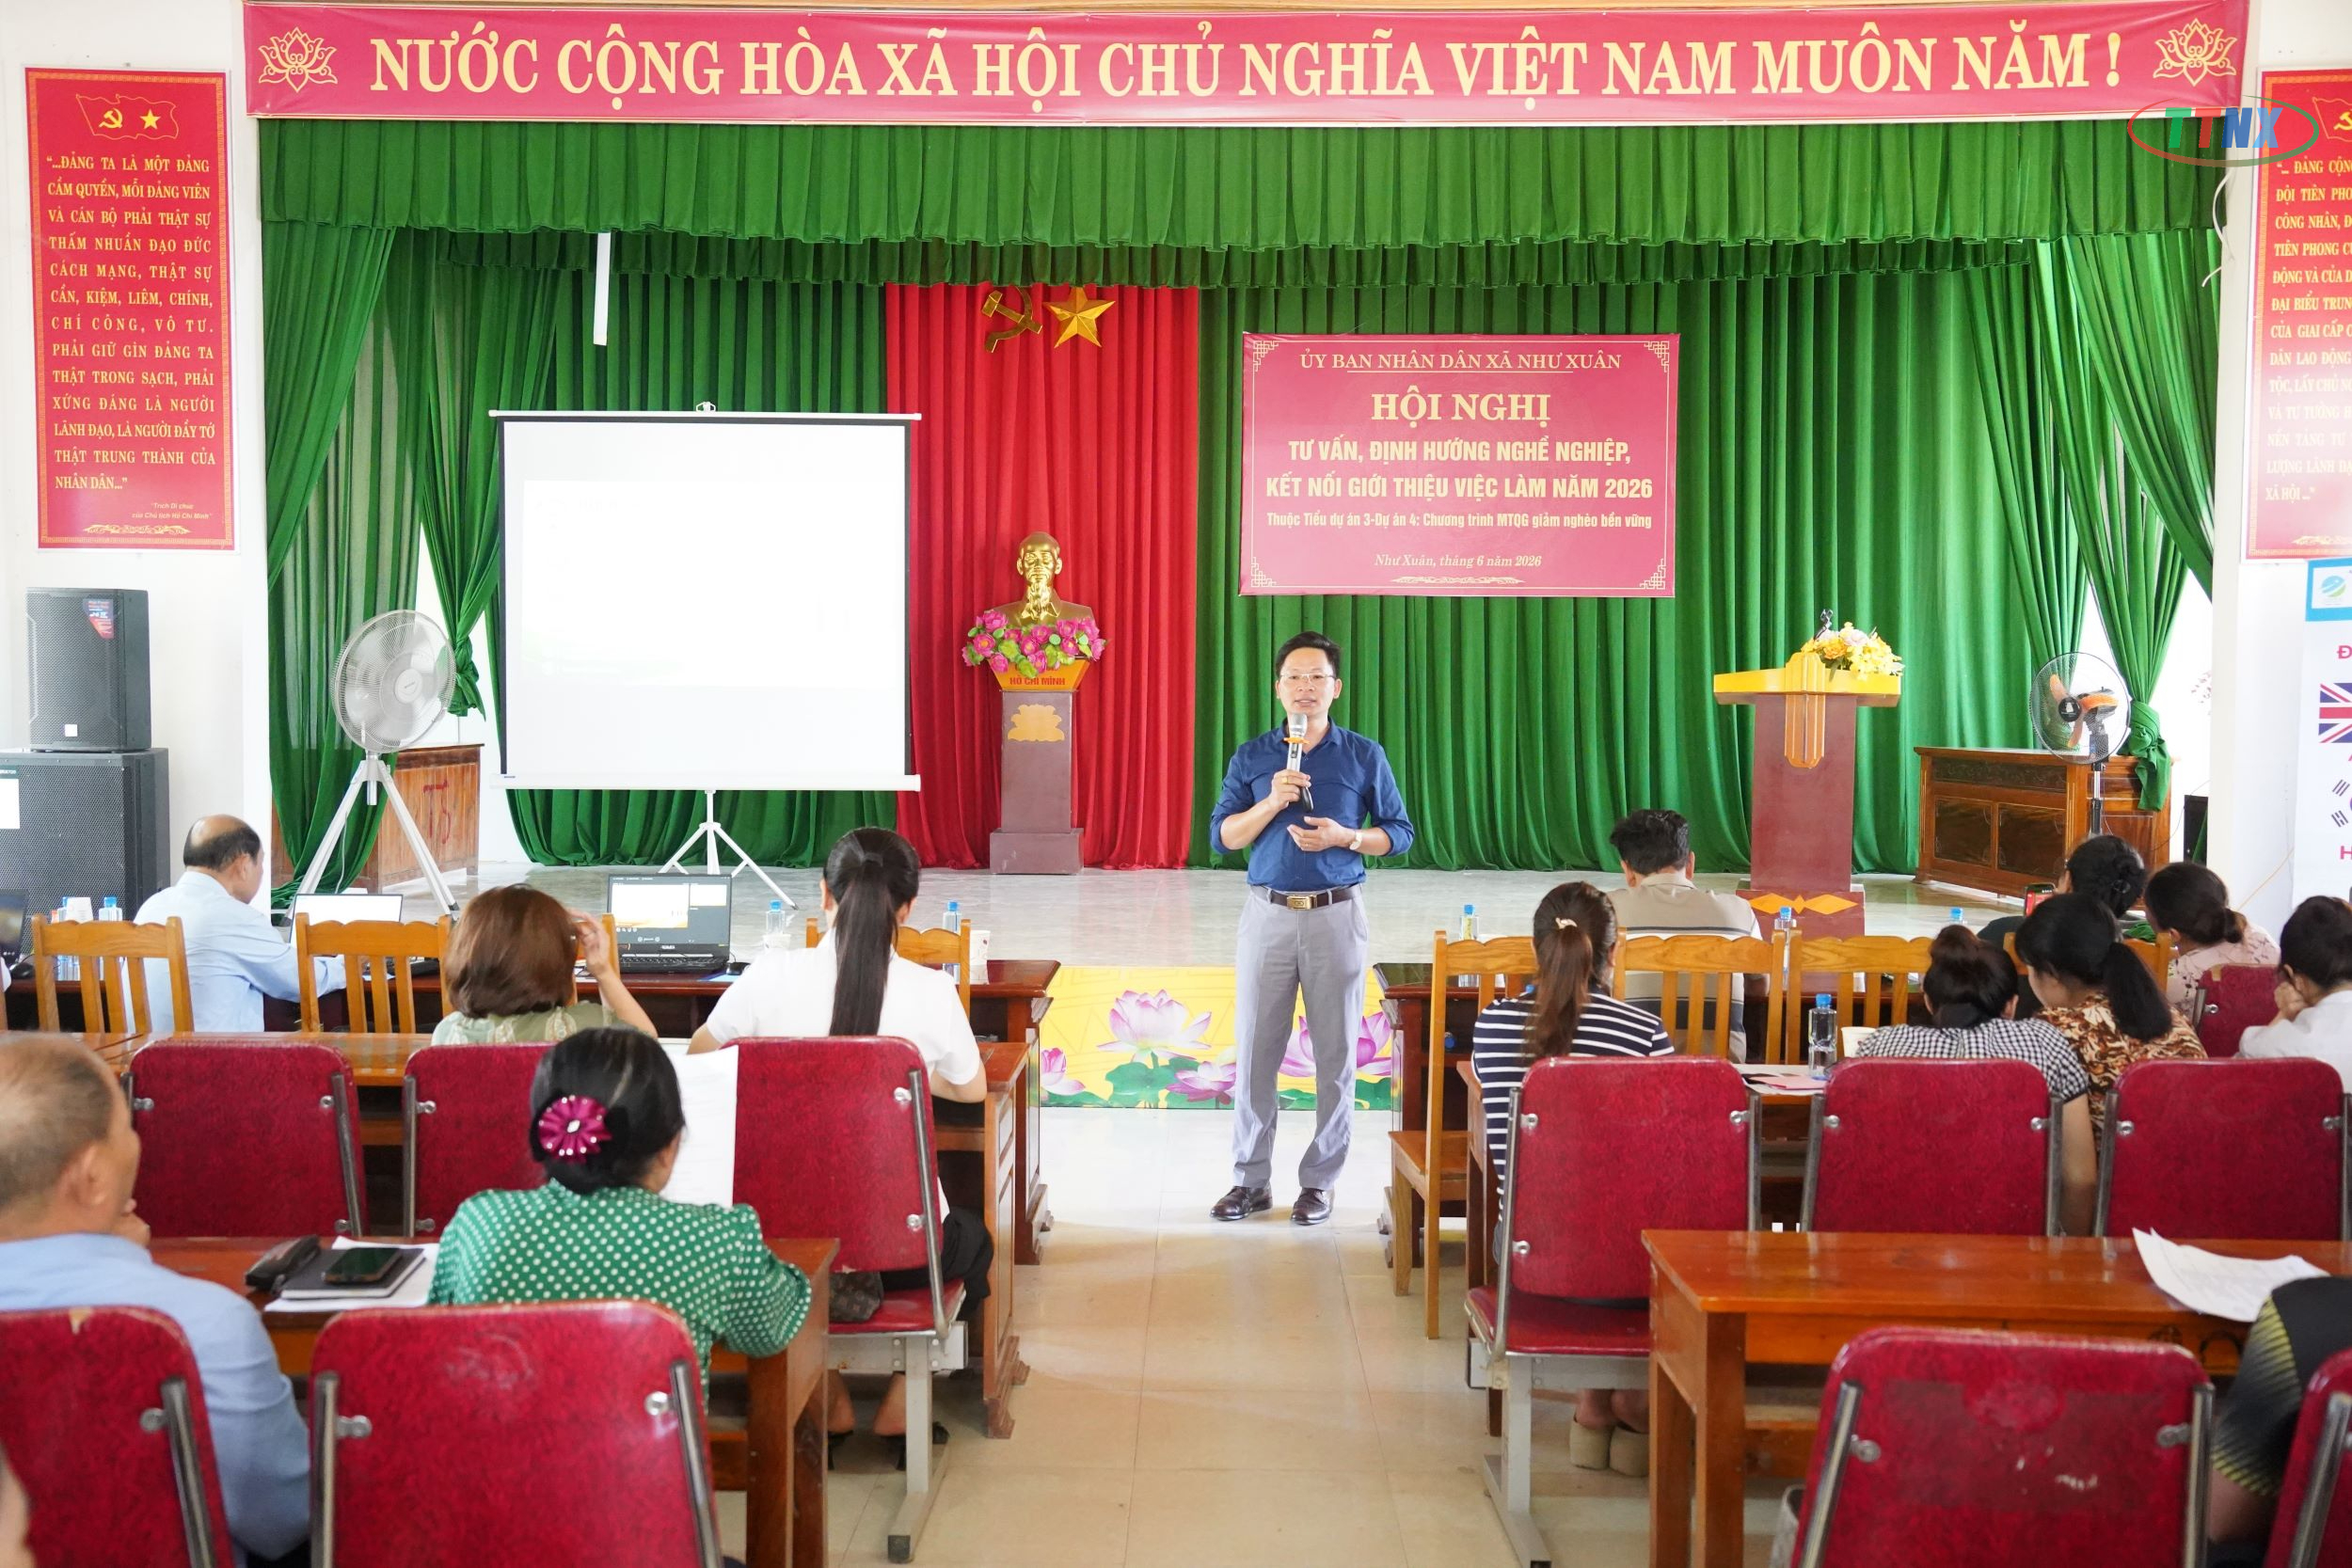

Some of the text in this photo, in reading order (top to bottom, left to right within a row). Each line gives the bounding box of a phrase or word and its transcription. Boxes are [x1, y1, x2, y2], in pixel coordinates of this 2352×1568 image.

[371, 21, 538, 94] NƯỚC
[557, 24, 723, 110] CỘNG
[739, 26, 866, 96] HÒA
[876, 27, 958, 96] XÃ
[972, 27, 1081, 113] HỘI
[1099, 21, 1224, 98] CHỦ
[1238, 28, 1435, 98] NGHĨA
[1446, 26, 1587, 111] VIỆT
[1601, 40, 1737, 96] NAM
[1752, 22, 1937, 95] MUÔN
[1950, 20, 2091, 92] NĂM
[101, 157, 116, 170] TA
[122, 154, 137, 171] LÀ
[145, 154, 169, 174] MỘT
[177, 154, 210, 173] ĐẢNG
[2328, 156, 2352, 176] CỘN
[2274, 239, 2340, 256] TIÊN PHONG
[51, 259, 213, 283] CÁCH MẠNG, THẬT SỰ
[53, 339, 214, 359] PHẢI GIỮ GÌN ĐẢNG TA
[1300, 348, 1621, 369] ỦY BAN NHÂN DÂN XÃ NHƯ XUÂN
[53, 366, 215, 388] THẬT TRONG SẠCH, PHẢI
[53, 394, 215, 412] XỨNG ĐÁNG LÀ NGƯỜI
[1372, 385, 1550, 428] HỘI NGHỊ
[55, 446, 215, 467] THẬT TRUNG THÀNH CỦA
[1289, 434, 1630, 466] TƯ VẤN, ĐỊNH HƯỚNG NGHỀ NGHIỆP,
[1266, 470, 1653, 502] KẾT NỐI GIỚI THIỆU VIỆC LÀM NĂM 2026
[1267, 512, 1300, 529] Thuộc
[1304, 510, 1327, 526] Tiểu
[1330, 513, 1343, 529] dự
[1347, 513, 1360, 526] án
[1392, 513, 1406, 526] án
[1409, 513, 1420, 527] 4:
[1423, 513, 1465, 528] Chương
[1439, 555, 1474, 568] tháng
[1477, 556, 1484, 566] 6
[1486, 556, 1512, 566] năm
[1516, 555, 1542, 566] 2026
